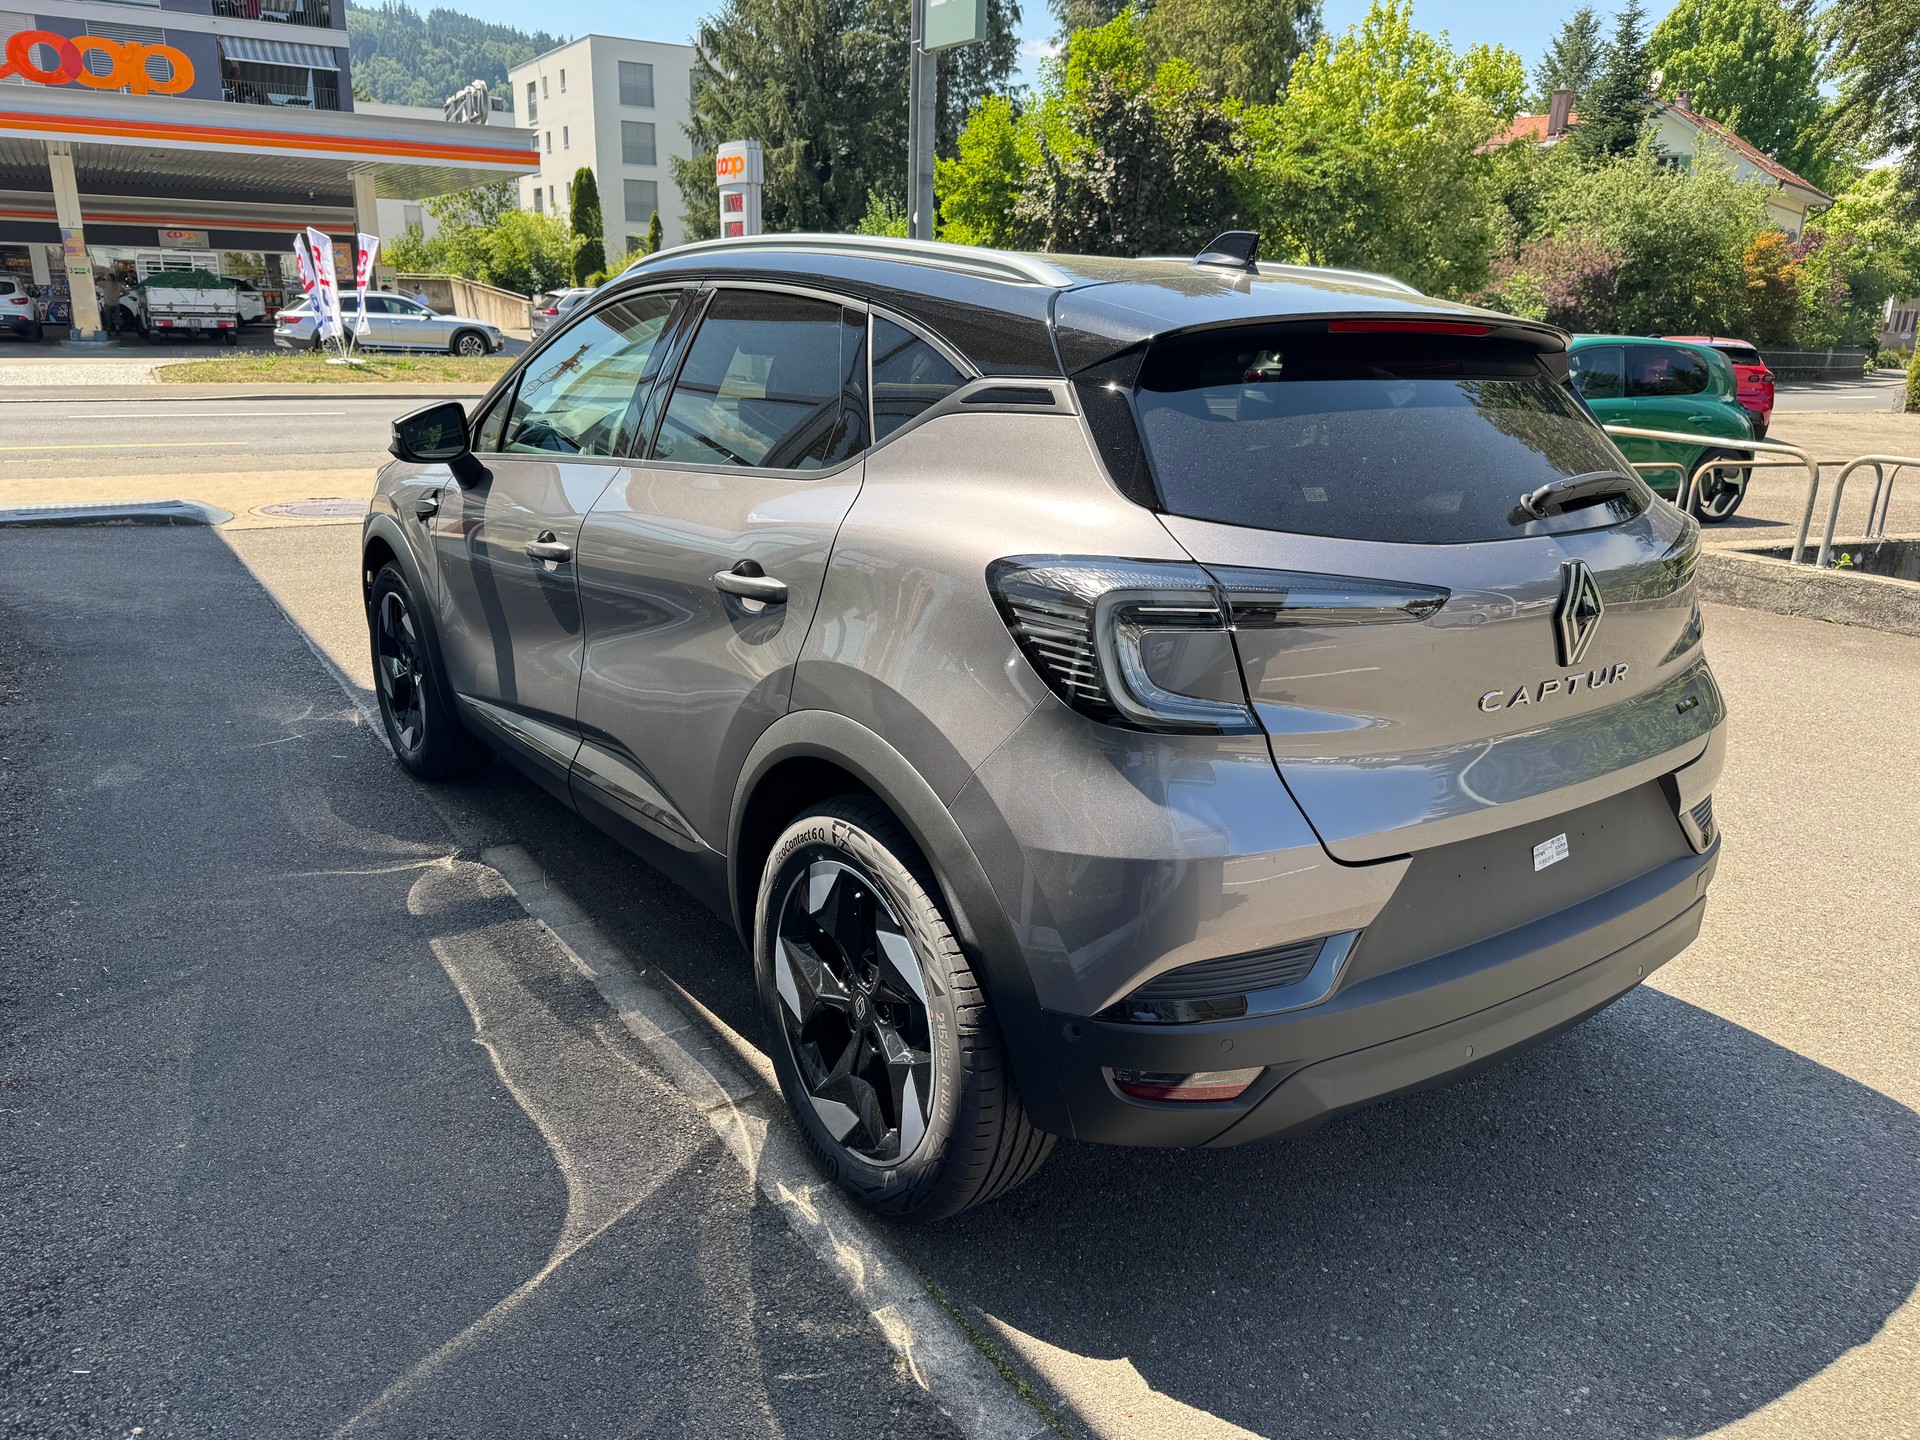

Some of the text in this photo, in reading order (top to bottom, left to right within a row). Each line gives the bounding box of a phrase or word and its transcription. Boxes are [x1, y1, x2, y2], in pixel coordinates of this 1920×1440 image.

[0, 30, 195, 96] oop
[1478, 662, 1629, 713] CAPTUR
[774, 827, 826, 866] EcoContact 6 Q
[935, 1012, 952, 1069] 215/55
[940, 1088, 951, 1107] 18
[941, 1073, 951, 1086] R
